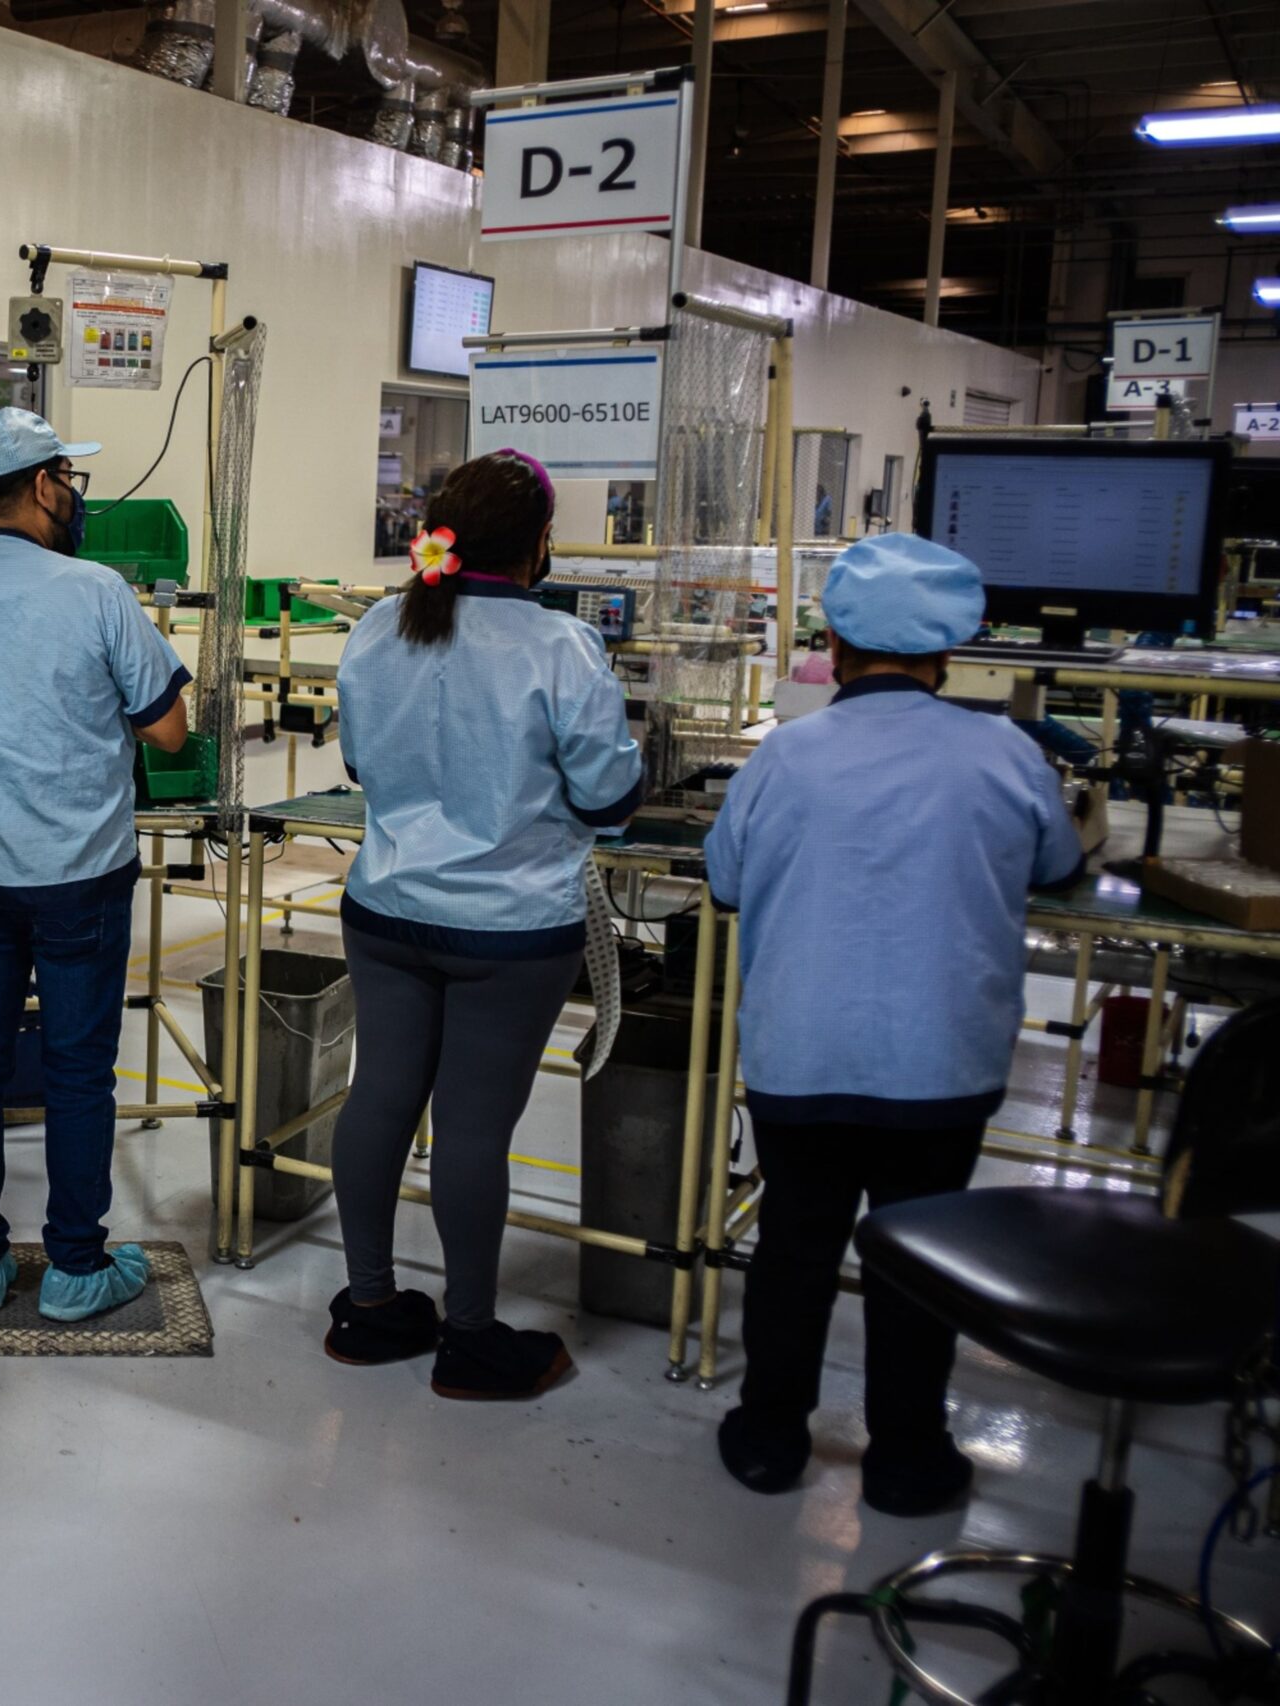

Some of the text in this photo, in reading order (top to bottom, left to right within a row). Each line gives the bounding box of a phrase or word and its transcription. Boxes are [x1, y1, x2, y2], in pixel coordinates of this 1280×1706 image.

[521, 138, 636, 199] D-2
[1133, 337, 1192, 363] D-1
[481, 401, 650, 424] LAT9600-6510E
[1246, 418, 1279, 431] A-2
